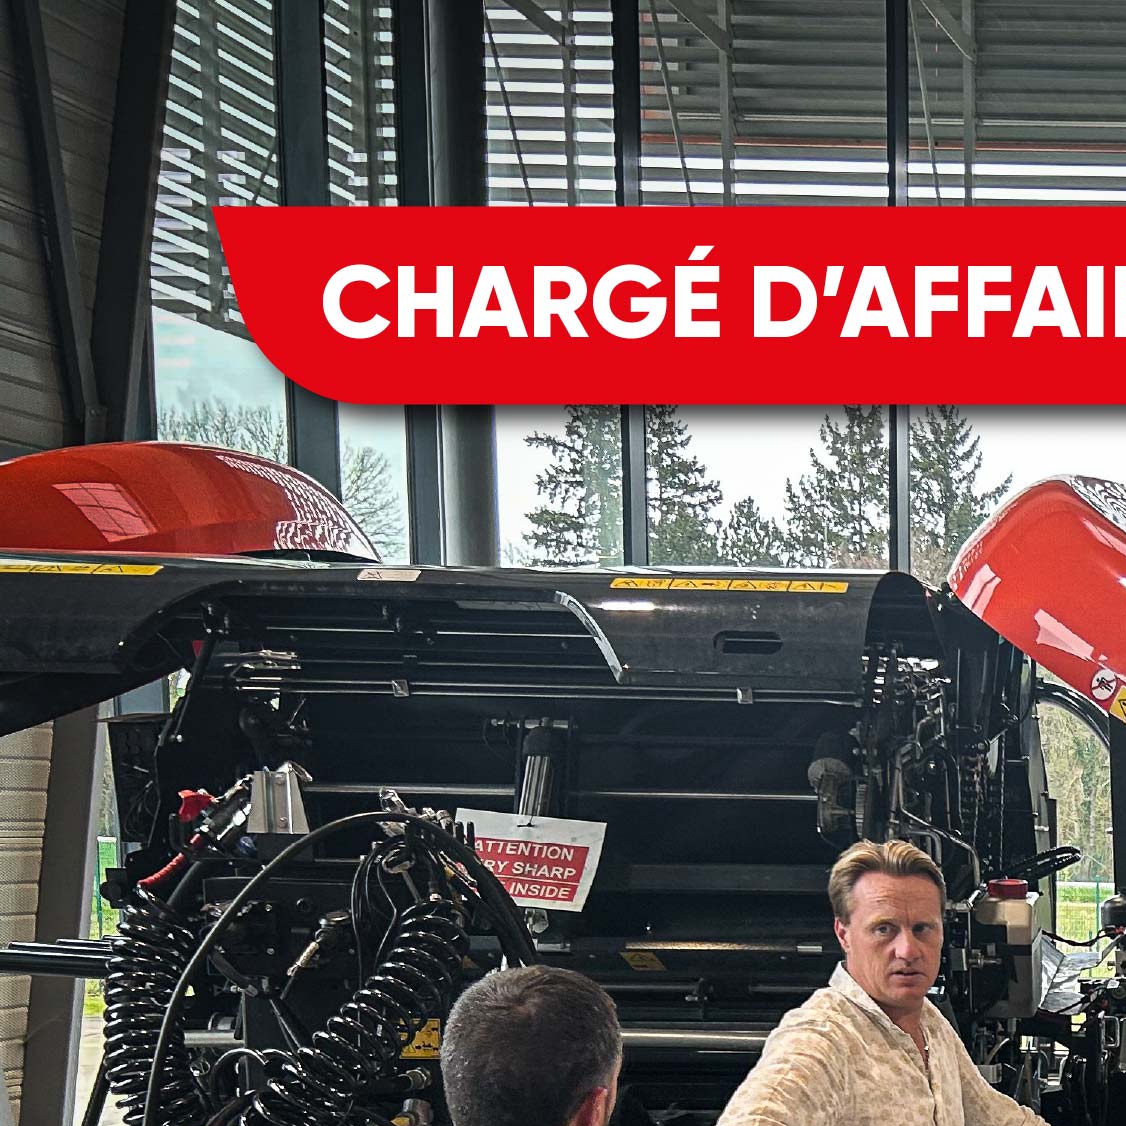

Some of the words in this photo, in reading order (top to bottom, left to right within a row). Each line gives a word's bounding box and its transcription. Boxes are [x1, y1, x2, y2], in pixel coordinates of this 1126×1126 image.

[475, 840, 574, 861] ATTENTION
[512, 861, 577, 880] SHARP
[509, 881, 571, 898] INSIDE
